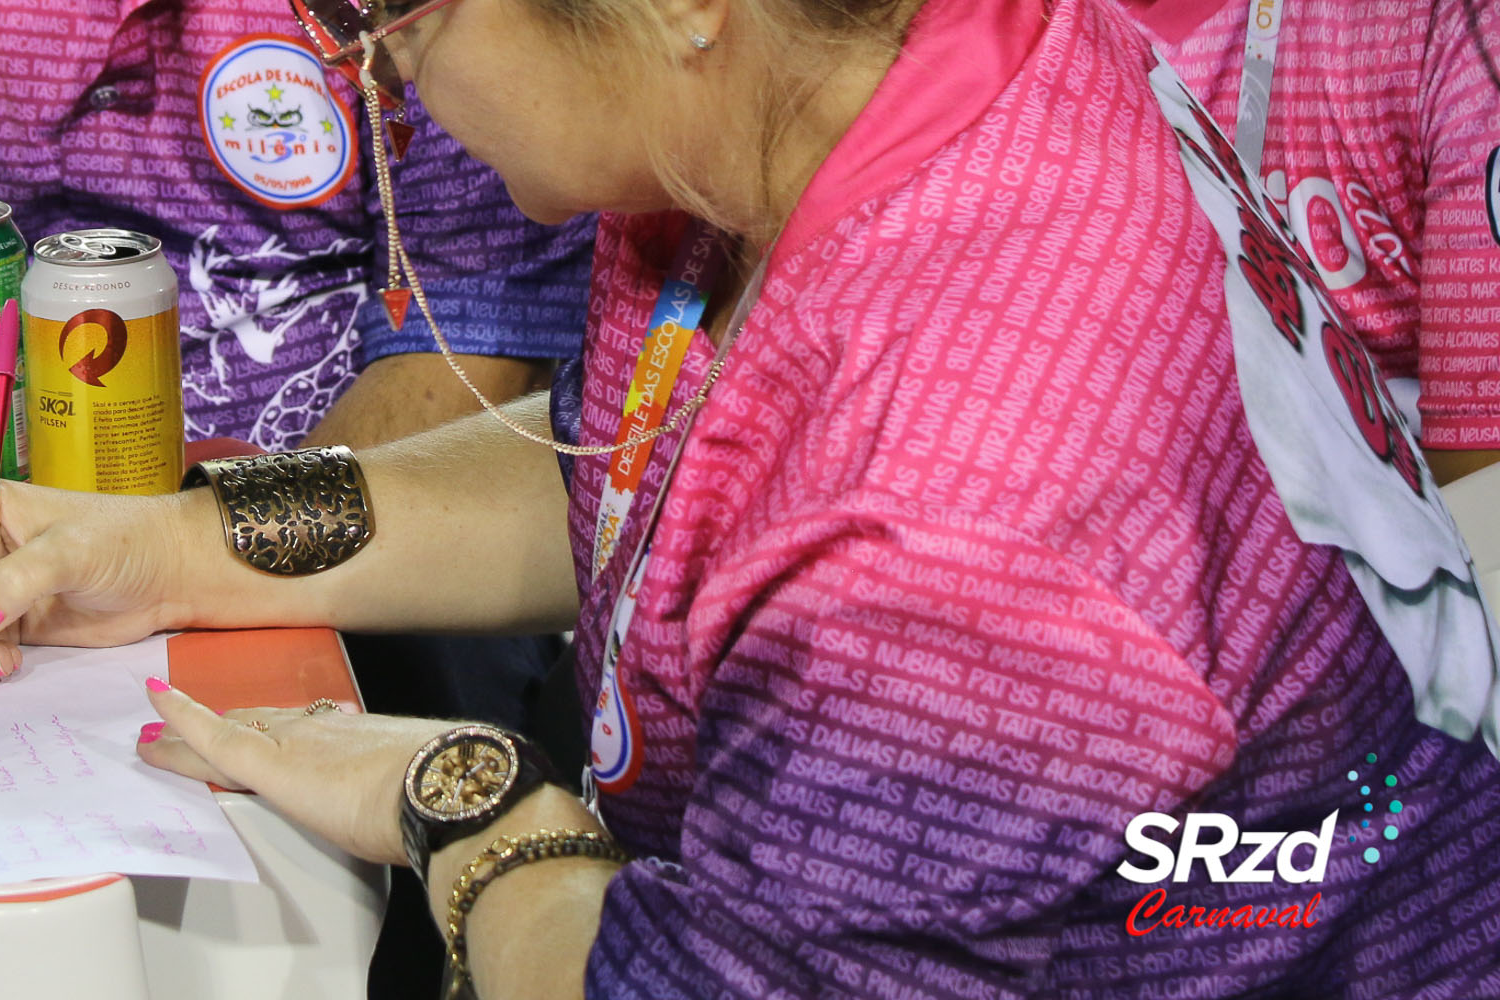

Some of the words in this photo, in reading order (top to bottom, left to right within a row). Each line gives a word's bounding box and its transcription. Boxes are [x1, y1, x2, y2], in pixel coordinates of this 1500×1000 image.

[216, 71, 263, 99] ESCOLA
[266, 69, 281, 82] DE
[84, 281, 132, 291] REDONDO
[650, 287, 693, 371] ESCOLAS
[643, 371, 662, 408] DAS
[39, 396, 76, 417] SKOL
[40, 415, 67, 429] PILSEN
